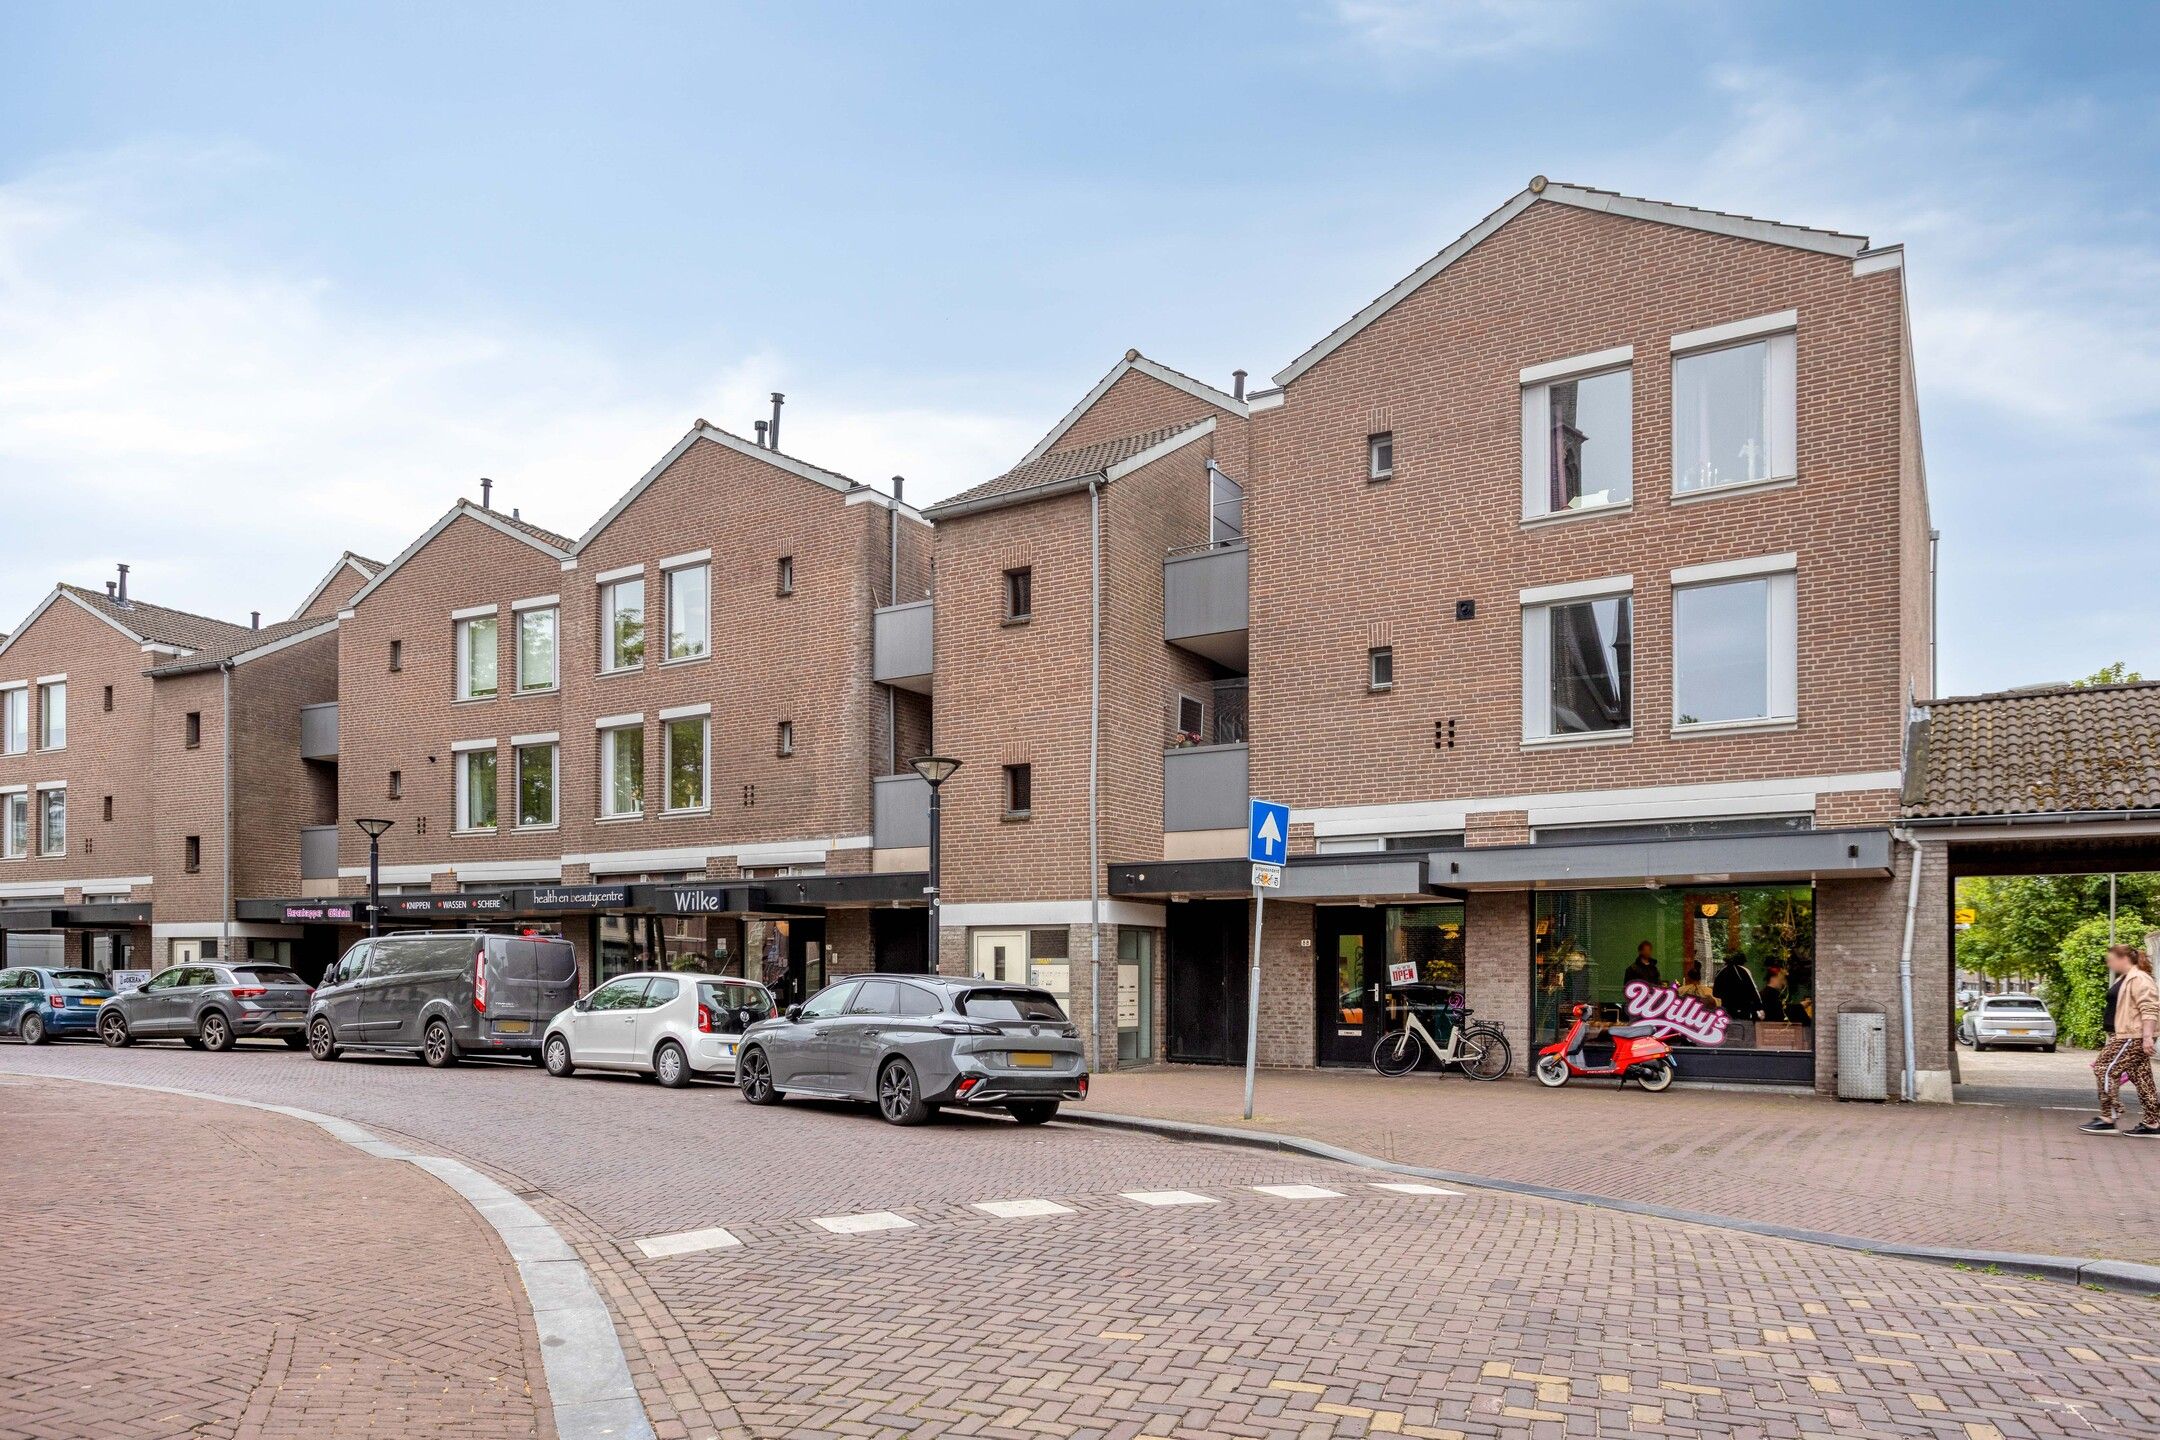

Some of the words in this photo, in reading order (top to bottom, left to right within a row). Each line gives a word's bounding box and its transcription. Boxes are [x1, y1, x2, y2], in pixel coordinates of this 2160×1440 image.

[406, 901, 431, 910] KNIPPEN
[442, 900, 467, 909] WASSEN
[477, 899, 501, 909] SCHERE
[533, 890, 557, 904] health
[558, 895, 569, 903] en
[674, 890, 719, 911] Wilke
[1392, 968, 1414, 983] OPEN
[1624, 981, 1730, 1045] Willy's
